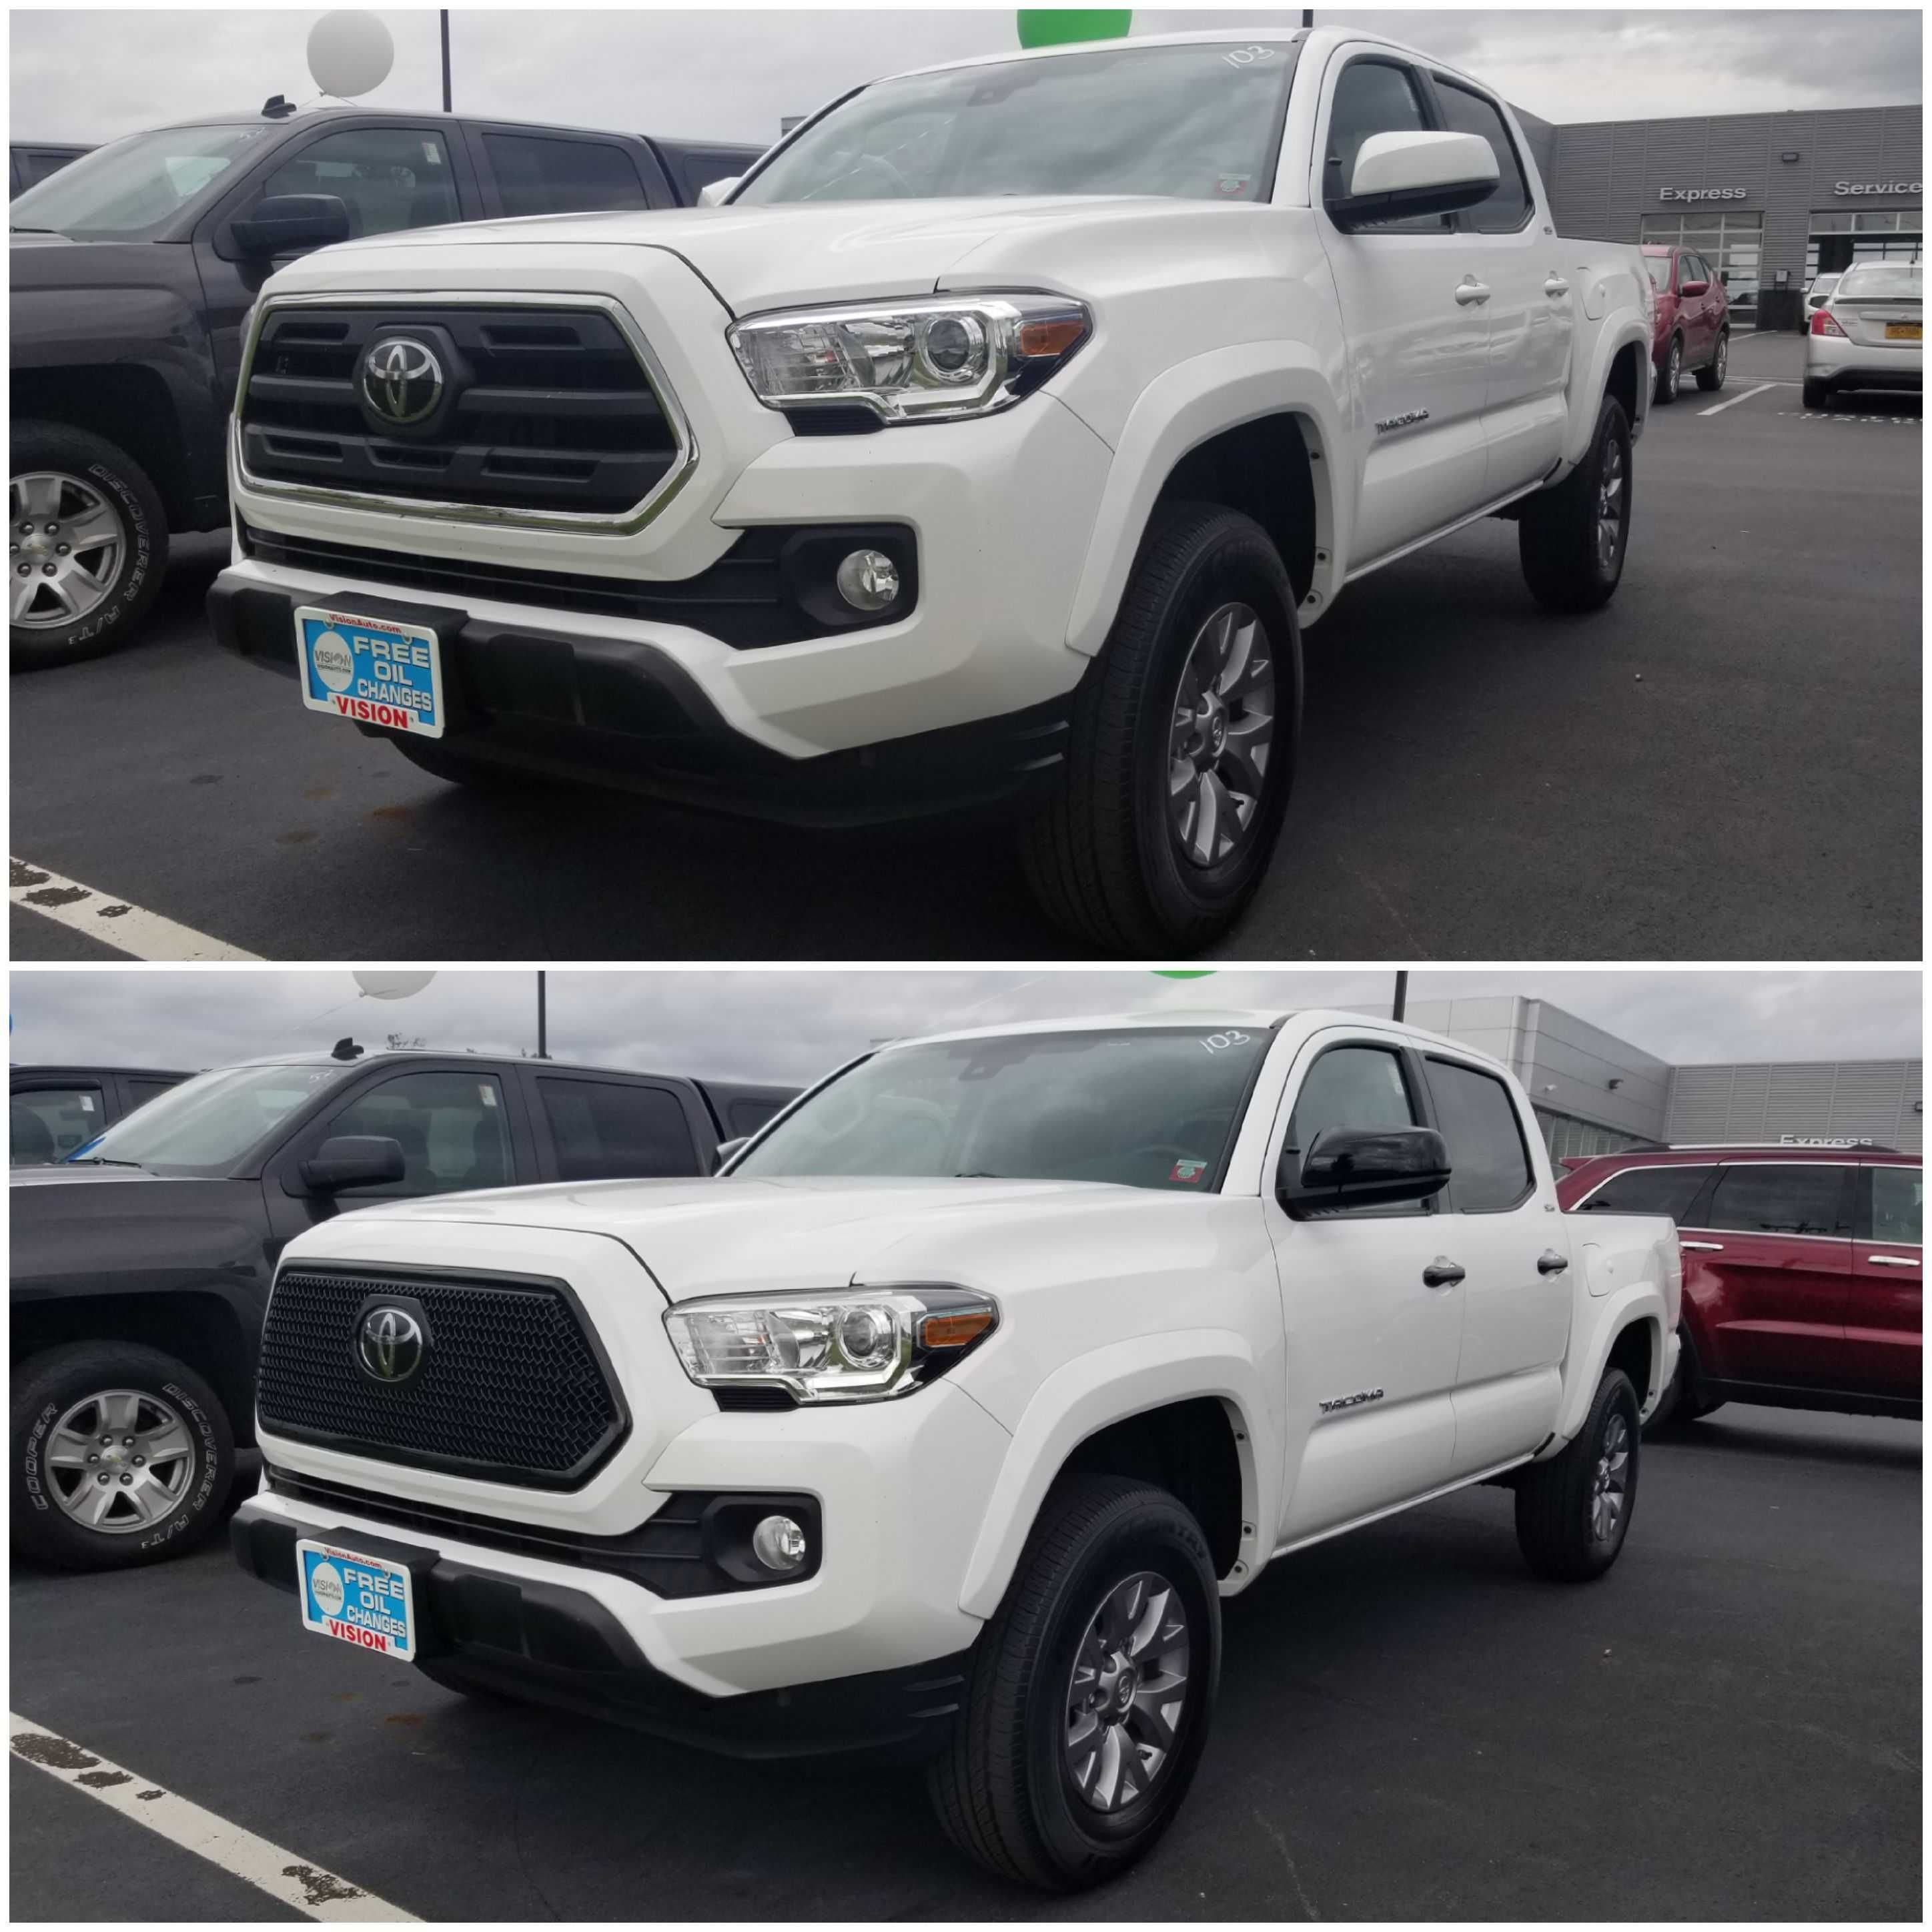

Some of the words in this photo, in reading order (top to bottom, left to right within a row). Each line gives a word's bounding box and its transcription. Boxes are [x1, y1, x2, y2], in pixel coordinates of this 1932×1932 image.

[1222, 45, 1275, 69] 103
[1659, 187, 1747, 201] Express
[1834, 180, 1923, 196] Service
[330, 613, 402, 633] VisionAuto.com
[315, 650, 352, 667] VISION
[352, 636, 430, 668] FREE
[373, 660, 412, 686] OIL
[357, 678, 432, 712] CHANGES
[336, 695, 408, 729] VISION
[1199, 1030, 1251, 1054] 103
[25, 1402, 58, 1511] COOPER
[162, 1382, 217, 1511] DISCOVERER
[344, 1568, 405, 1600] FREE
[360, 1591, 392, 1616] OIL
[329, 1619, 387, 1652] VISION
[347, 1605, 406, 1638] CHANGES
